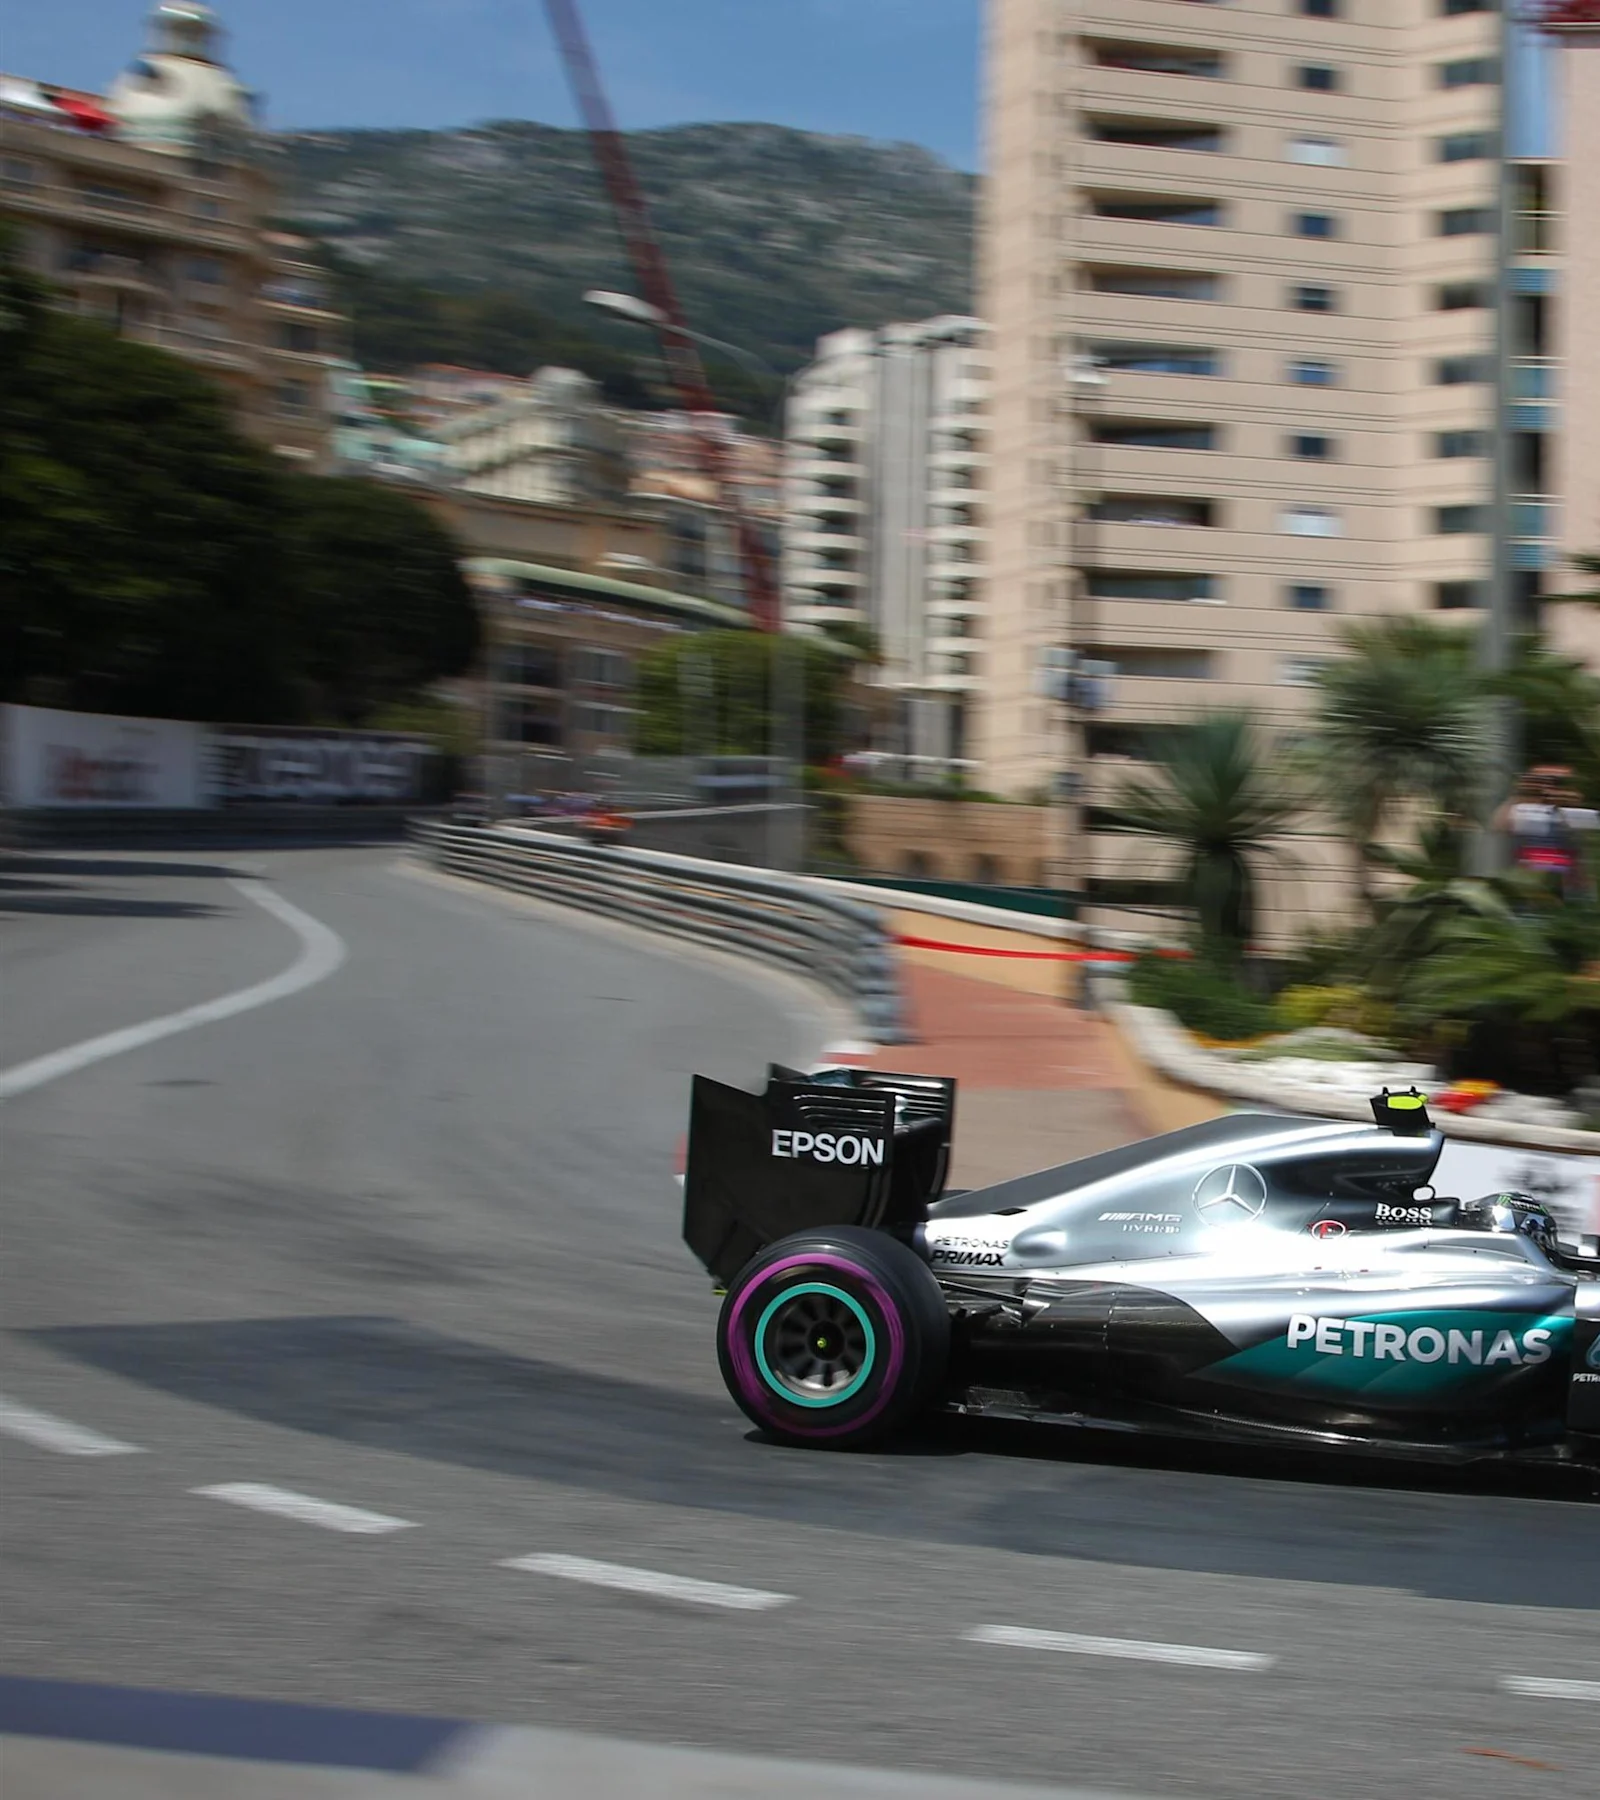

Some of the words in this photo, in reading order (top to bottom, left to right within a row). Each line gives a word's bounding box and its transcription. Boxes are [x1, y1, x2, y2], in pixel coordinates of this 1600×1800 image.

[772, 1128, 885, 1166] EPSON
[1374, 1202, 1432, 1219] BOSS
[934, 1236, 1009, 1249] PETRONAS
[930, 1249, 1004, 1266] PRIMAX
[1287, 1313, 1551, 1365] PETRONAS
